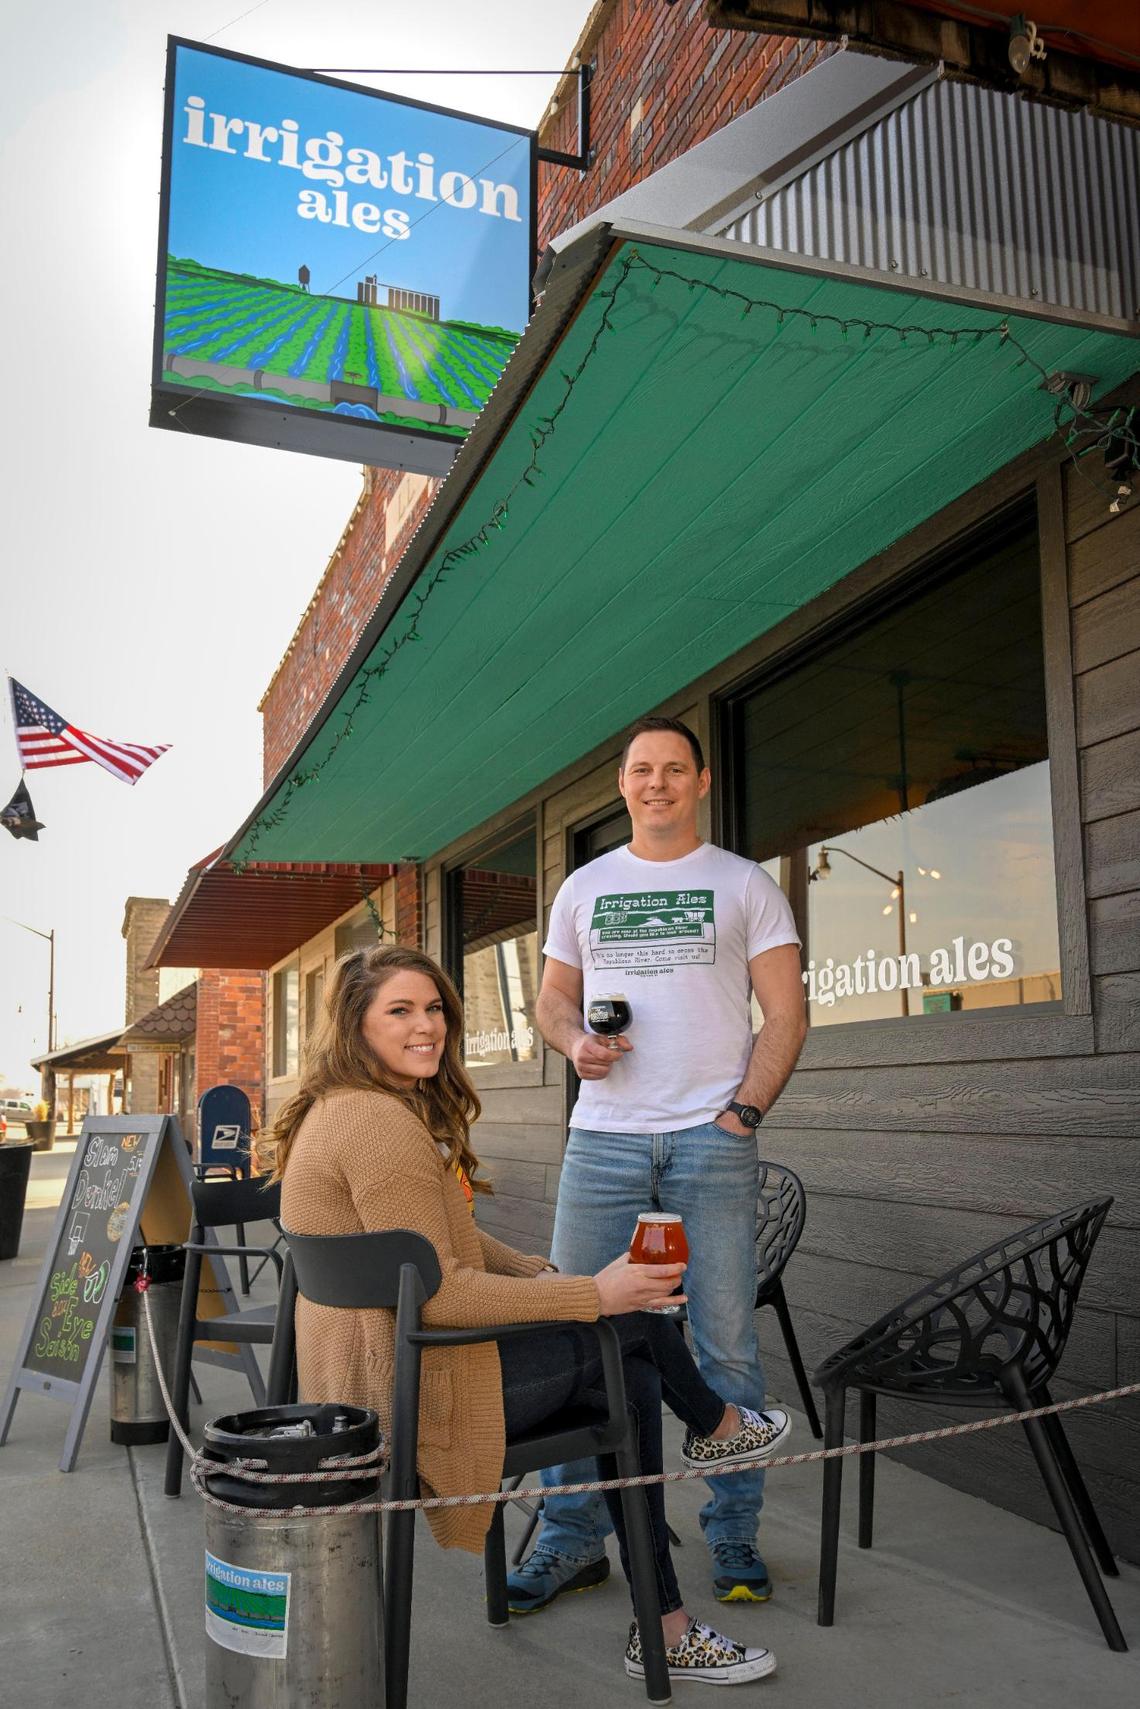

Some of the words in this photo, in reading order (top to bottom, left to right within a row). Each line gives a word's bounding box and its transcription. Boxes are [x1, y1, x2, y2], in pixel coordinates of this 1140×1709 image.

[183, 96, 522, 222] irrigation
[297, 189, 411, 240] ales
[600, 895, 668, 910] Irrigation
[676, 892, 707, 905] Ales
[801, 949, 924, 1007] igation
[930, 936, 1014, 986] ales
[511, 1026, 534, 1049] as
[84, 1136, 119, 1168] Slam
[51, 1262, 79, 1301] Side
[252, 1578, 285, 1592] ales
